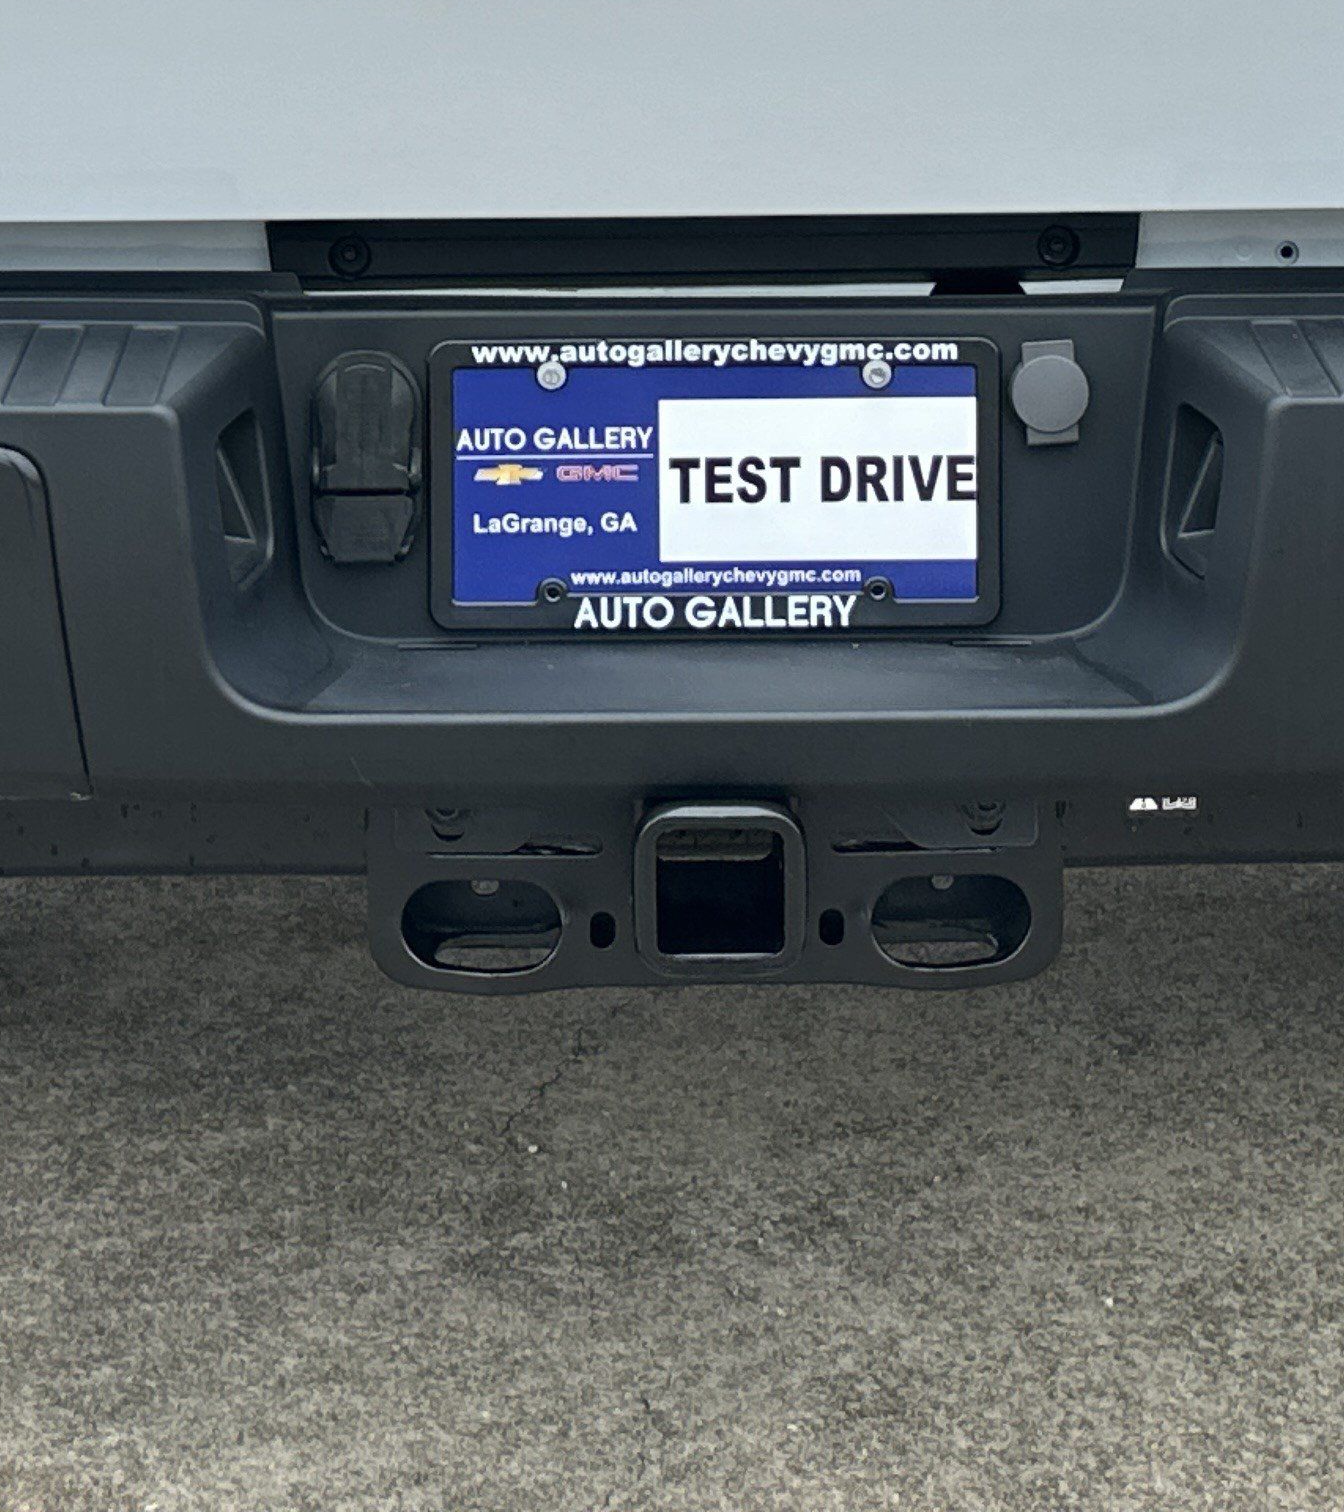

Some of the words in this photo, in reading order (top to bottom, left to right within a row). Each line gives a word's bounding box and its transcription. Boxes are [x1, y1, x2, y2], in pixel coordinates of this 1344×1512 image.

[471, 339, 959, 367] www.autogallerychevygmc.com
[456, 427, 527, 452] AUTO
[533, 425, 654, 451] GALLERY
[556, 464, 640, 482] GMC
[669, 456, 802, 505] TEST
[820, 454, 977, 503] DRIVE
[473, 513, 594, 538] LaGrange,
[600, 512, 638, 534] GA
[570, 567, 862, 587] www.autogallerychevygmc.com
[573, 595, 675, 629] AUTO
[684, 594, 857, 629] GALLERY
